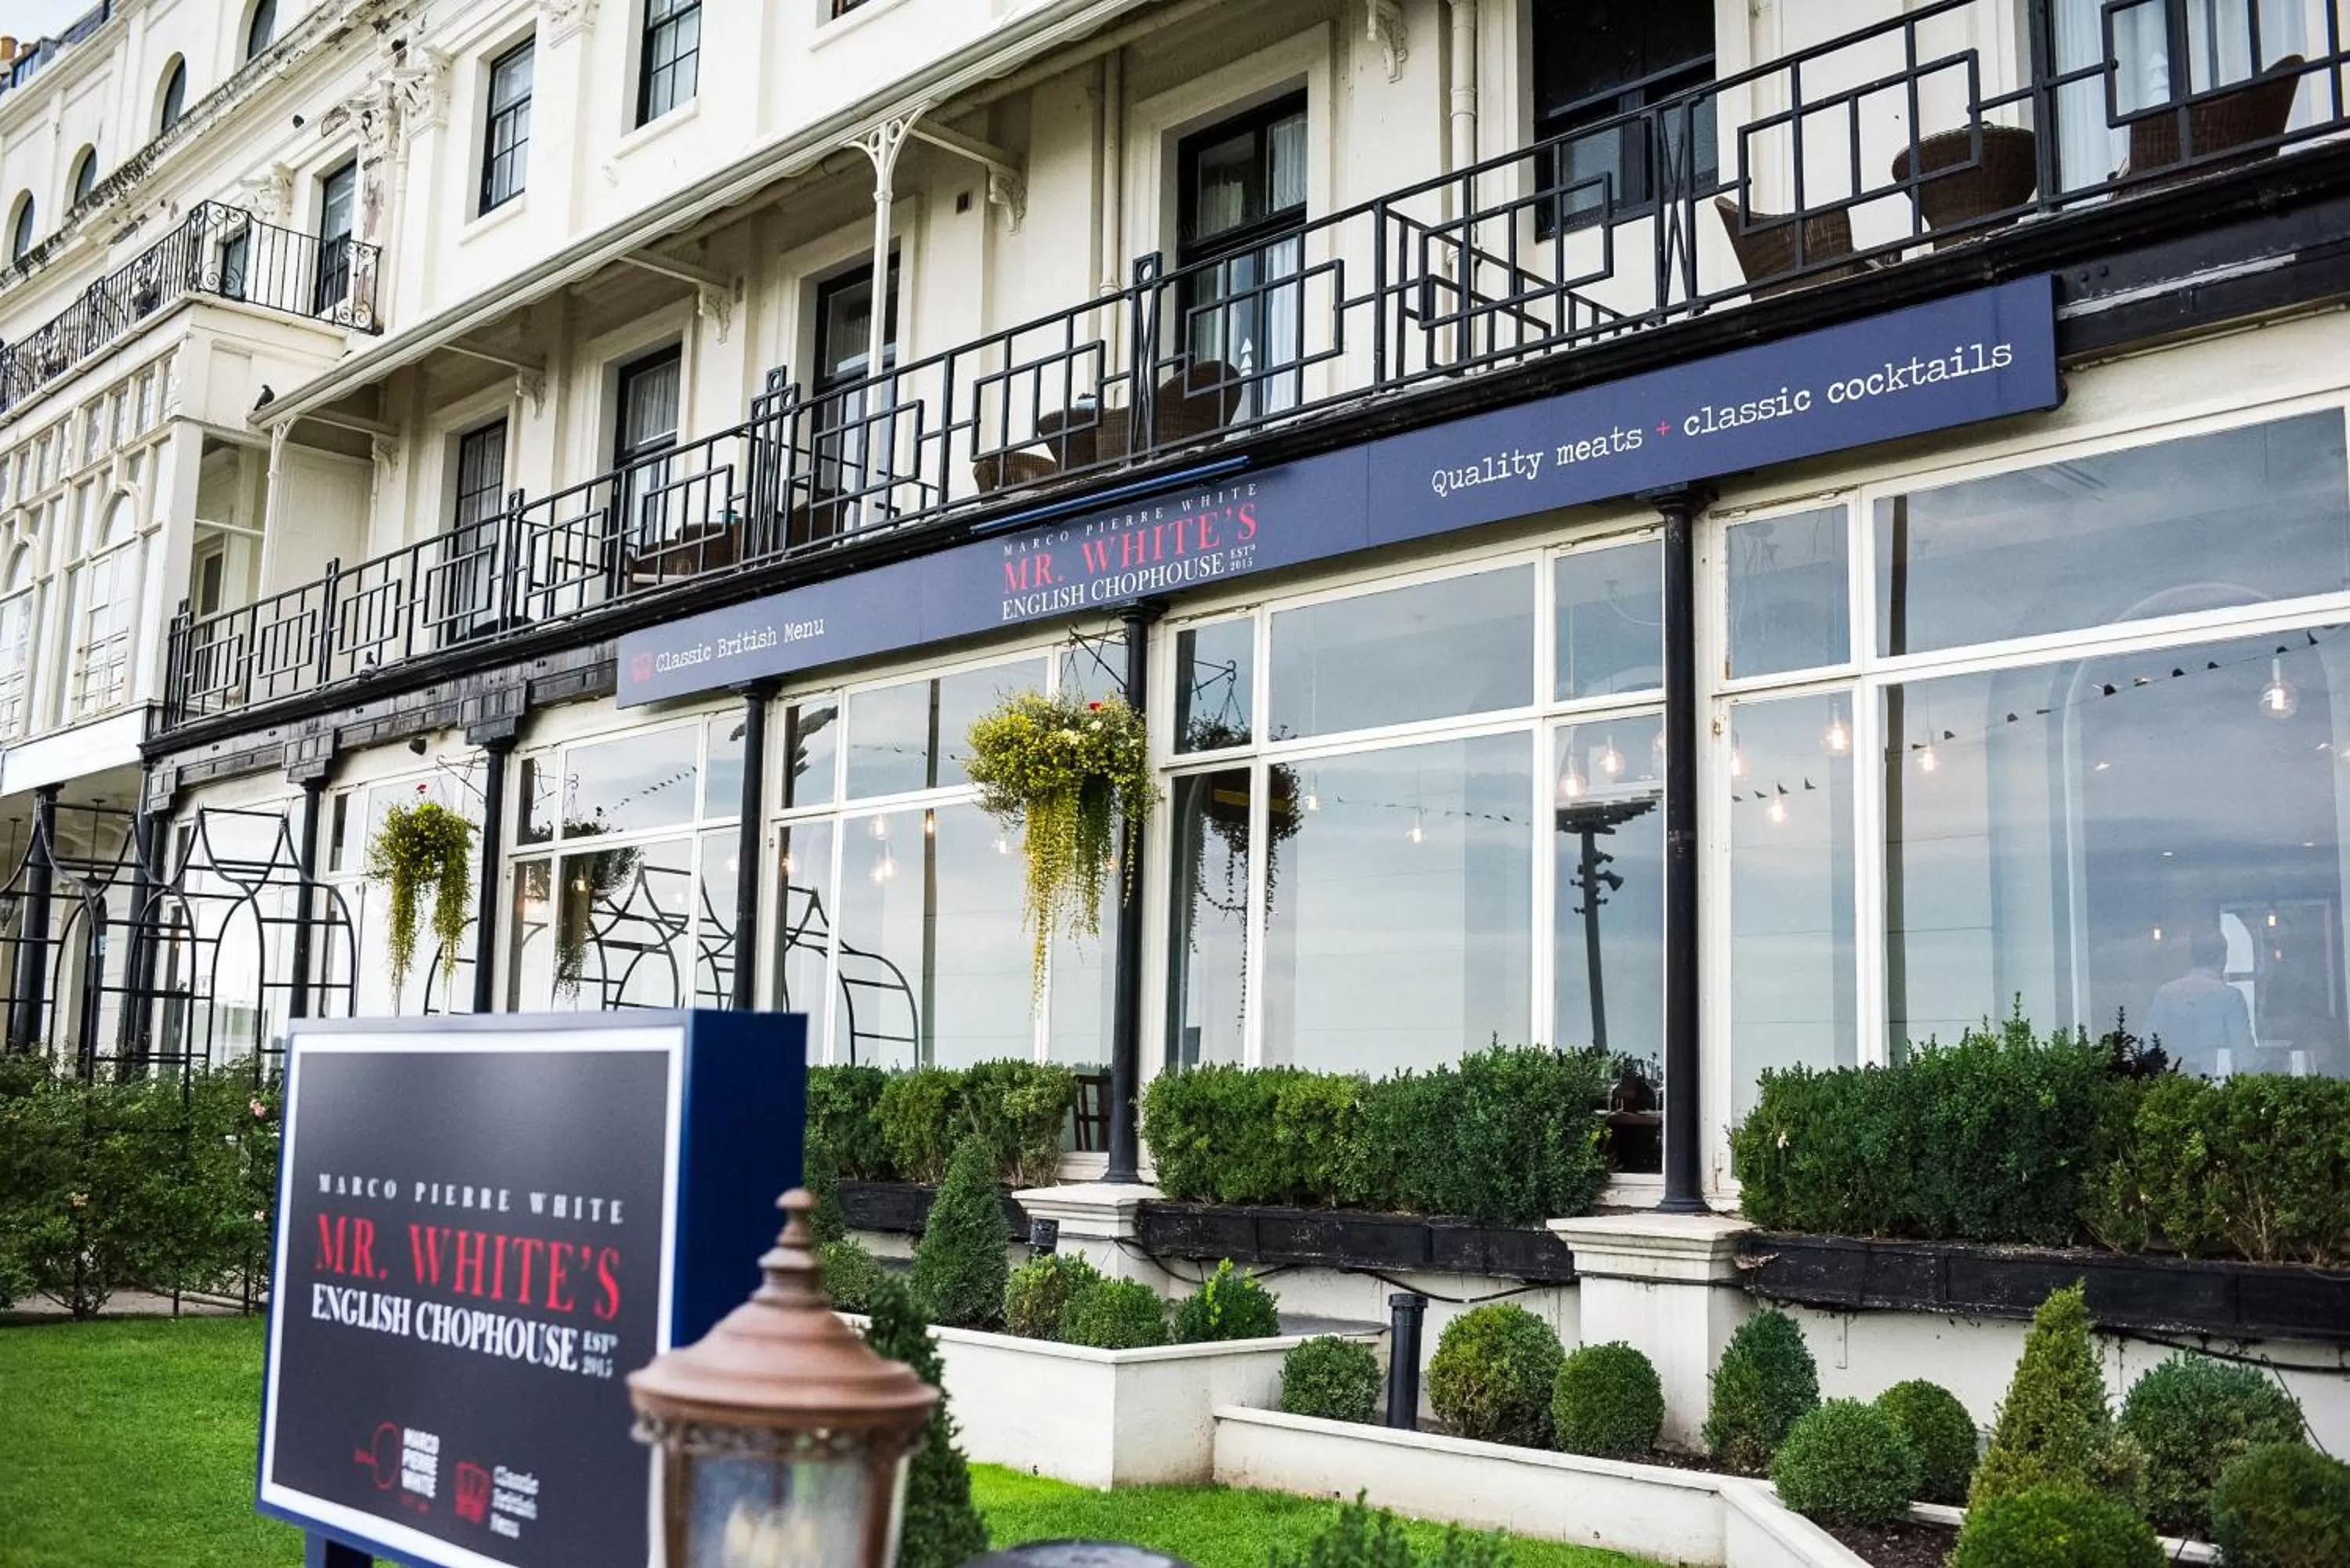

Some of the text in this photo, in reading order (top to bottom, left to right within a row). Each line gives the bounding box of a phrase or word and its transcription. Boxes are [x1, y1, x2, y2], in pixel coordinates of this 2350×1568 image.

[1431, 447, 1545, 497] Quality
[1556, 424, 1643, 467] meats
[1683, 387, 1811, 437] classic
[1827, 340, 2013, 406] cocktails
[1004, 483, 1257, 556] MARCO PIERRE WHITE
[1004, 502, 1258, 595] MR. WHITE'S
[1002, 552, 1224, 621] ENGLISH CHOPHOUSE
[656, 618, 824, 673] Classic British Menu
[318, 1173, 624, 1223] MARCO PIERRE WHITE
[316, 1213, 620, 1322] MR. WHITE'S
[311, 1283, 579, 1372] ENGLISH CHOPHOUSE
